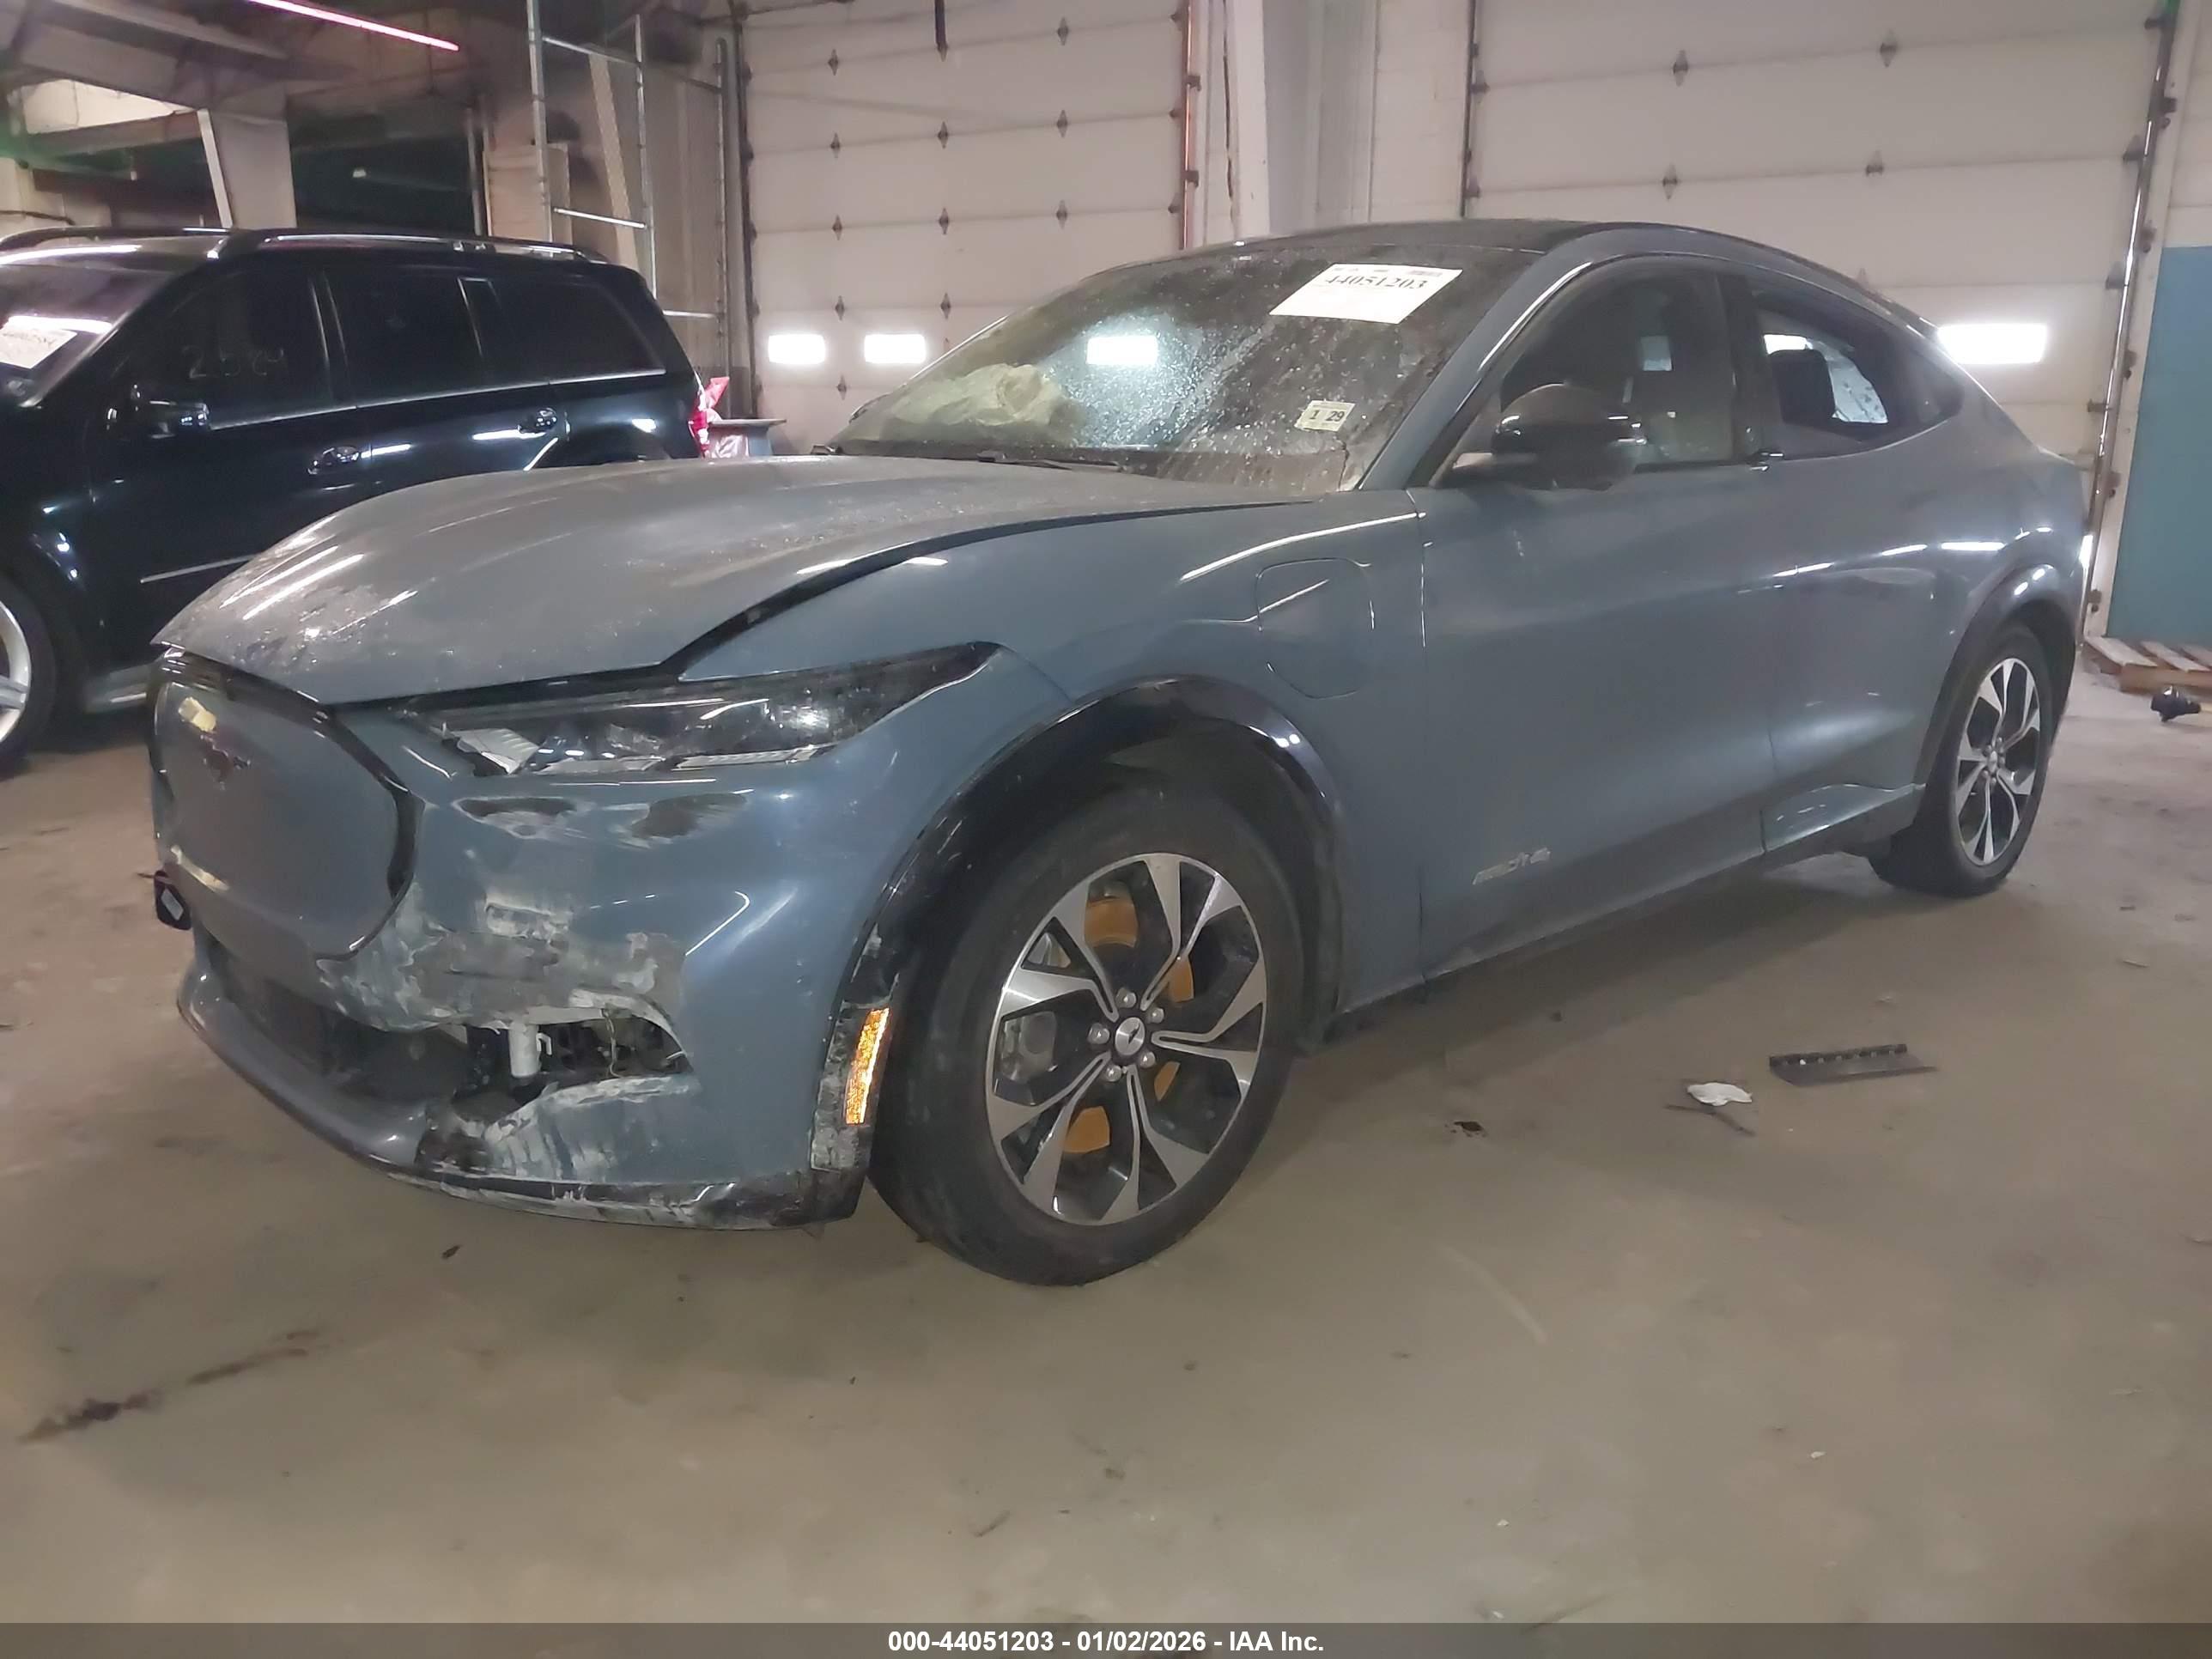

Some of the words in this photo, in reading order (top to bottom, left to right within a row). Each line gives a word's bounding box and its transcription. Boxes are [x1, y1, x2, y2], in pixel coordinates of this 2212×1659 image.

[1325, 275, 1428, 289] 44051203
[1309, 410, 1321, 420] 1
[1325, 410, 1345, 422] 29
